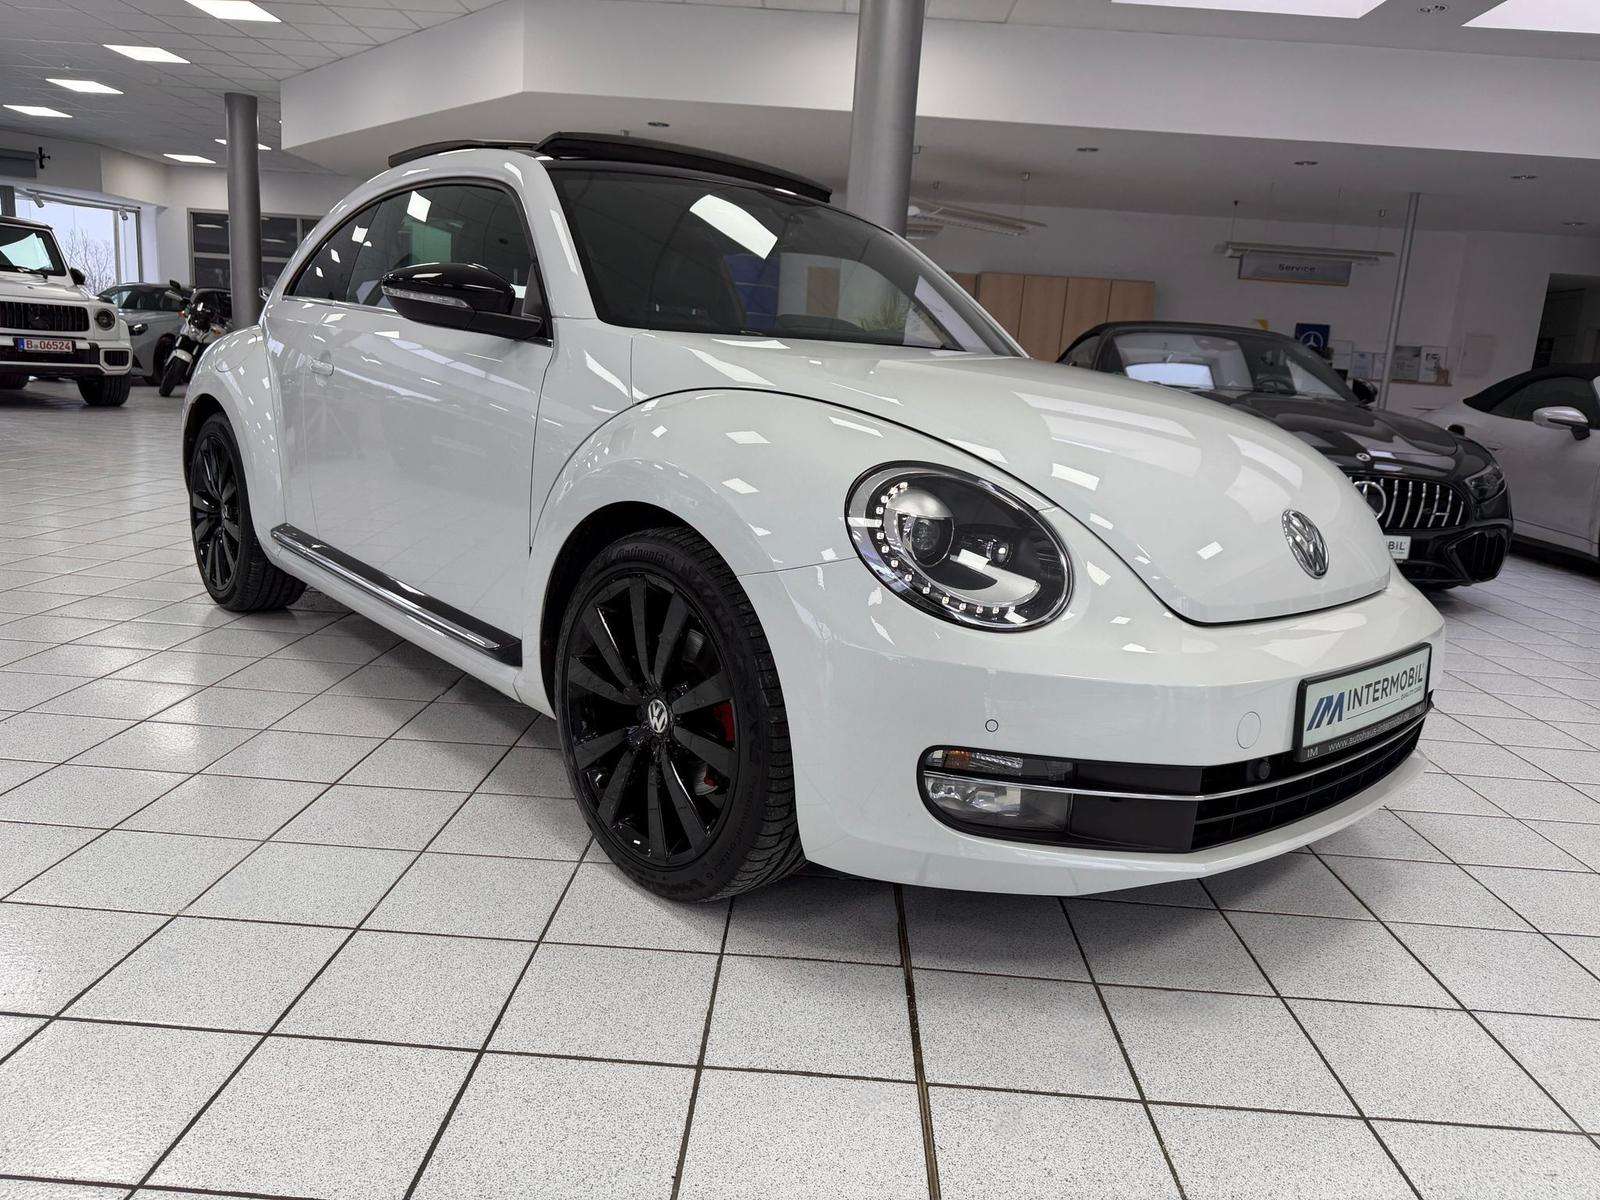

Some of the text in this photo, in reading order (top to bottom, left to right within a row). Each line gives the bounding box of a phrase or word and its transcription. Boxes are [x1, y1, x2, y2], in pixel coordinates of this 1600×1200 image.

[1278, 262, 1316, 273] Service
[26, 340, 71, 351] B 06524
[616, 546, 669, 564] Continental
[1347, 664, 1423, 711] INTERMOBIL
[1307, 747, 1319, 758] IM
